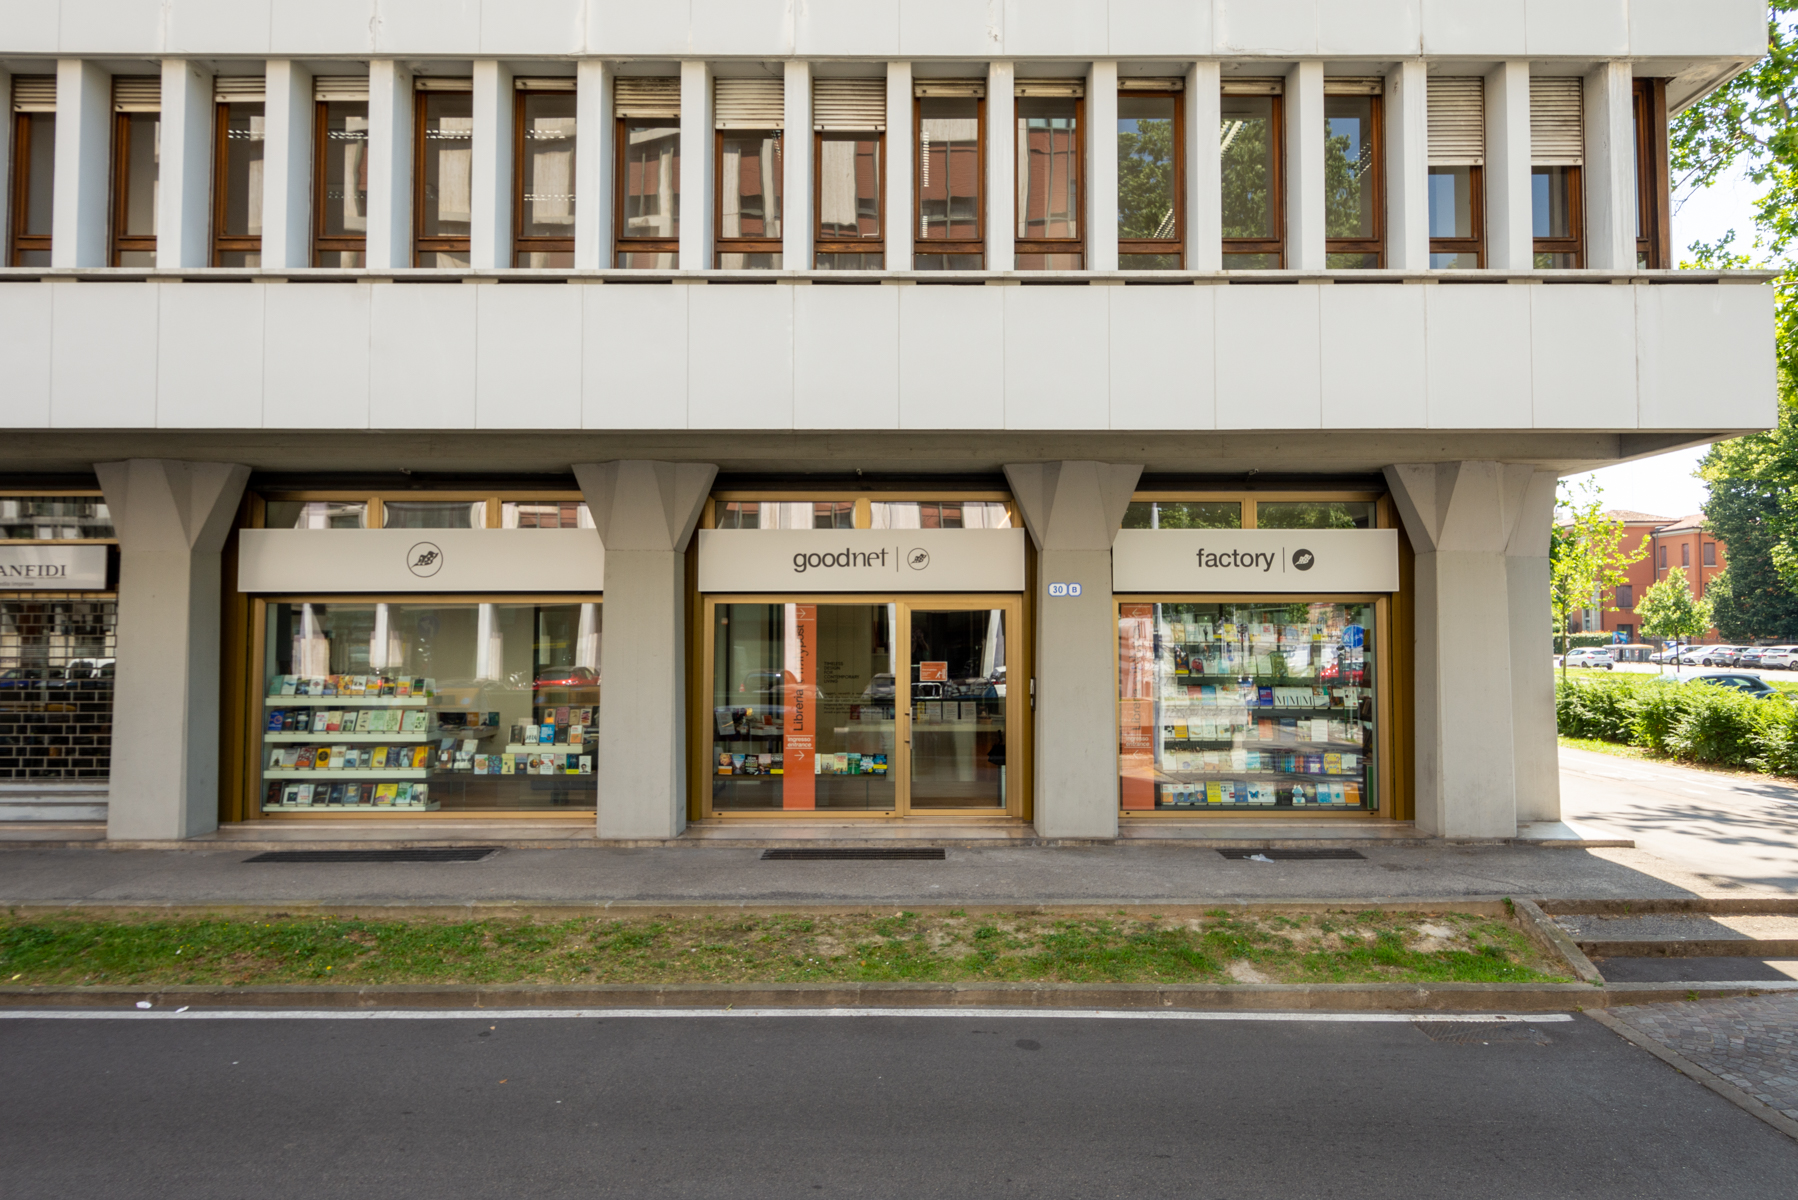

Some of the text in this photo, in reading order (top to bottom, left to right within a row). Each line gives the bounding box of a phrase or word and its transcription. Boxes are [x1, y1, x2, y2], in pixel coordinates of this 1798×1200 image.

[793, 547, 889, 573] goodnet
[1196, 548, 1276, 573] factory
[1052, 585, 1064, 594] 30
[793, 689, 804, 731] Libreria
